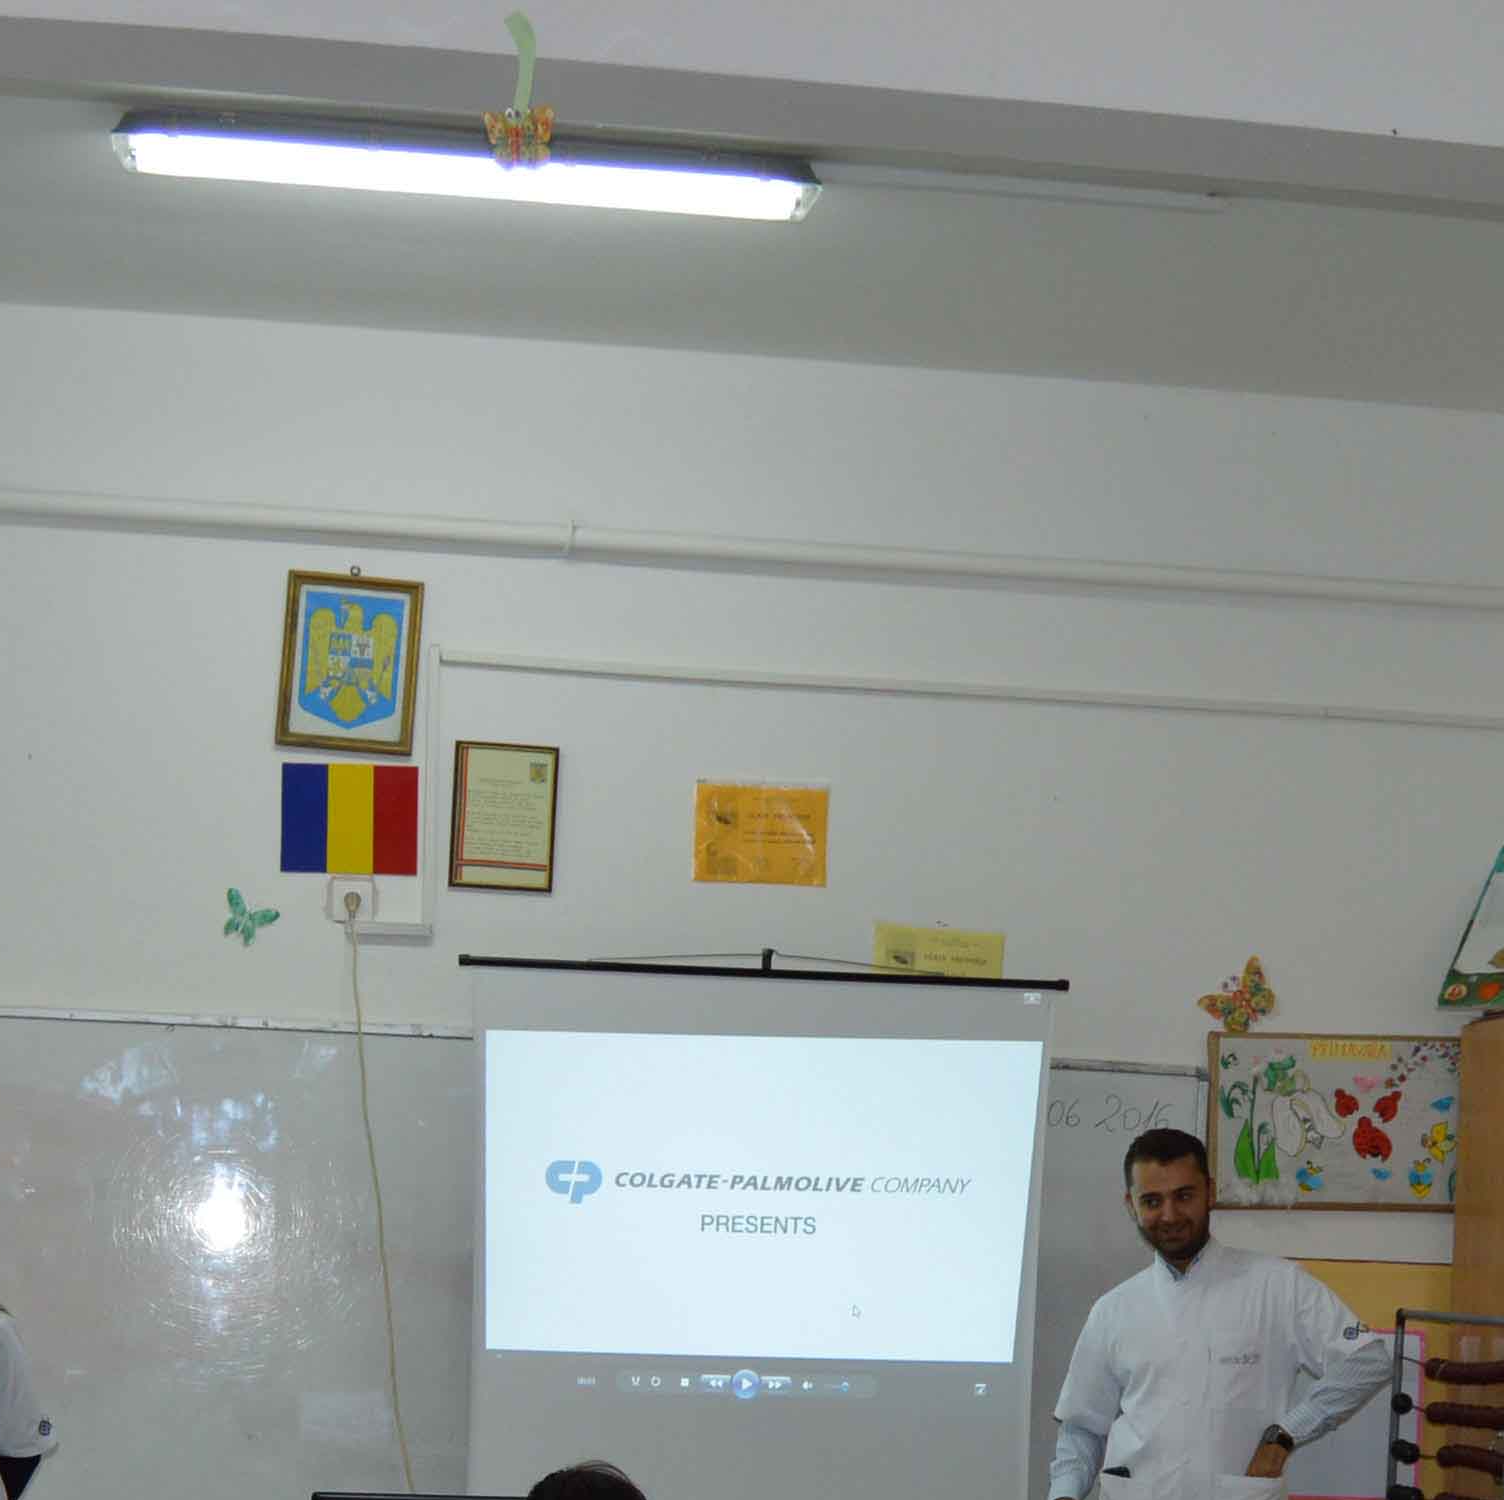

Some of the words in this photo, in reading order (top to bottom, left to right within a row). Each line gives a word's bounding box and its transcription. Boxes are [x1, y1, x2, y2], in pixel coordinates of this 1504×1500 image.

[613, 1169, 864, 1195] COLGATE-PALMOLIVE
[870, 1174, 972, 1195] COMPANY
[699, 1213, 817, 1237] PRESENTS
